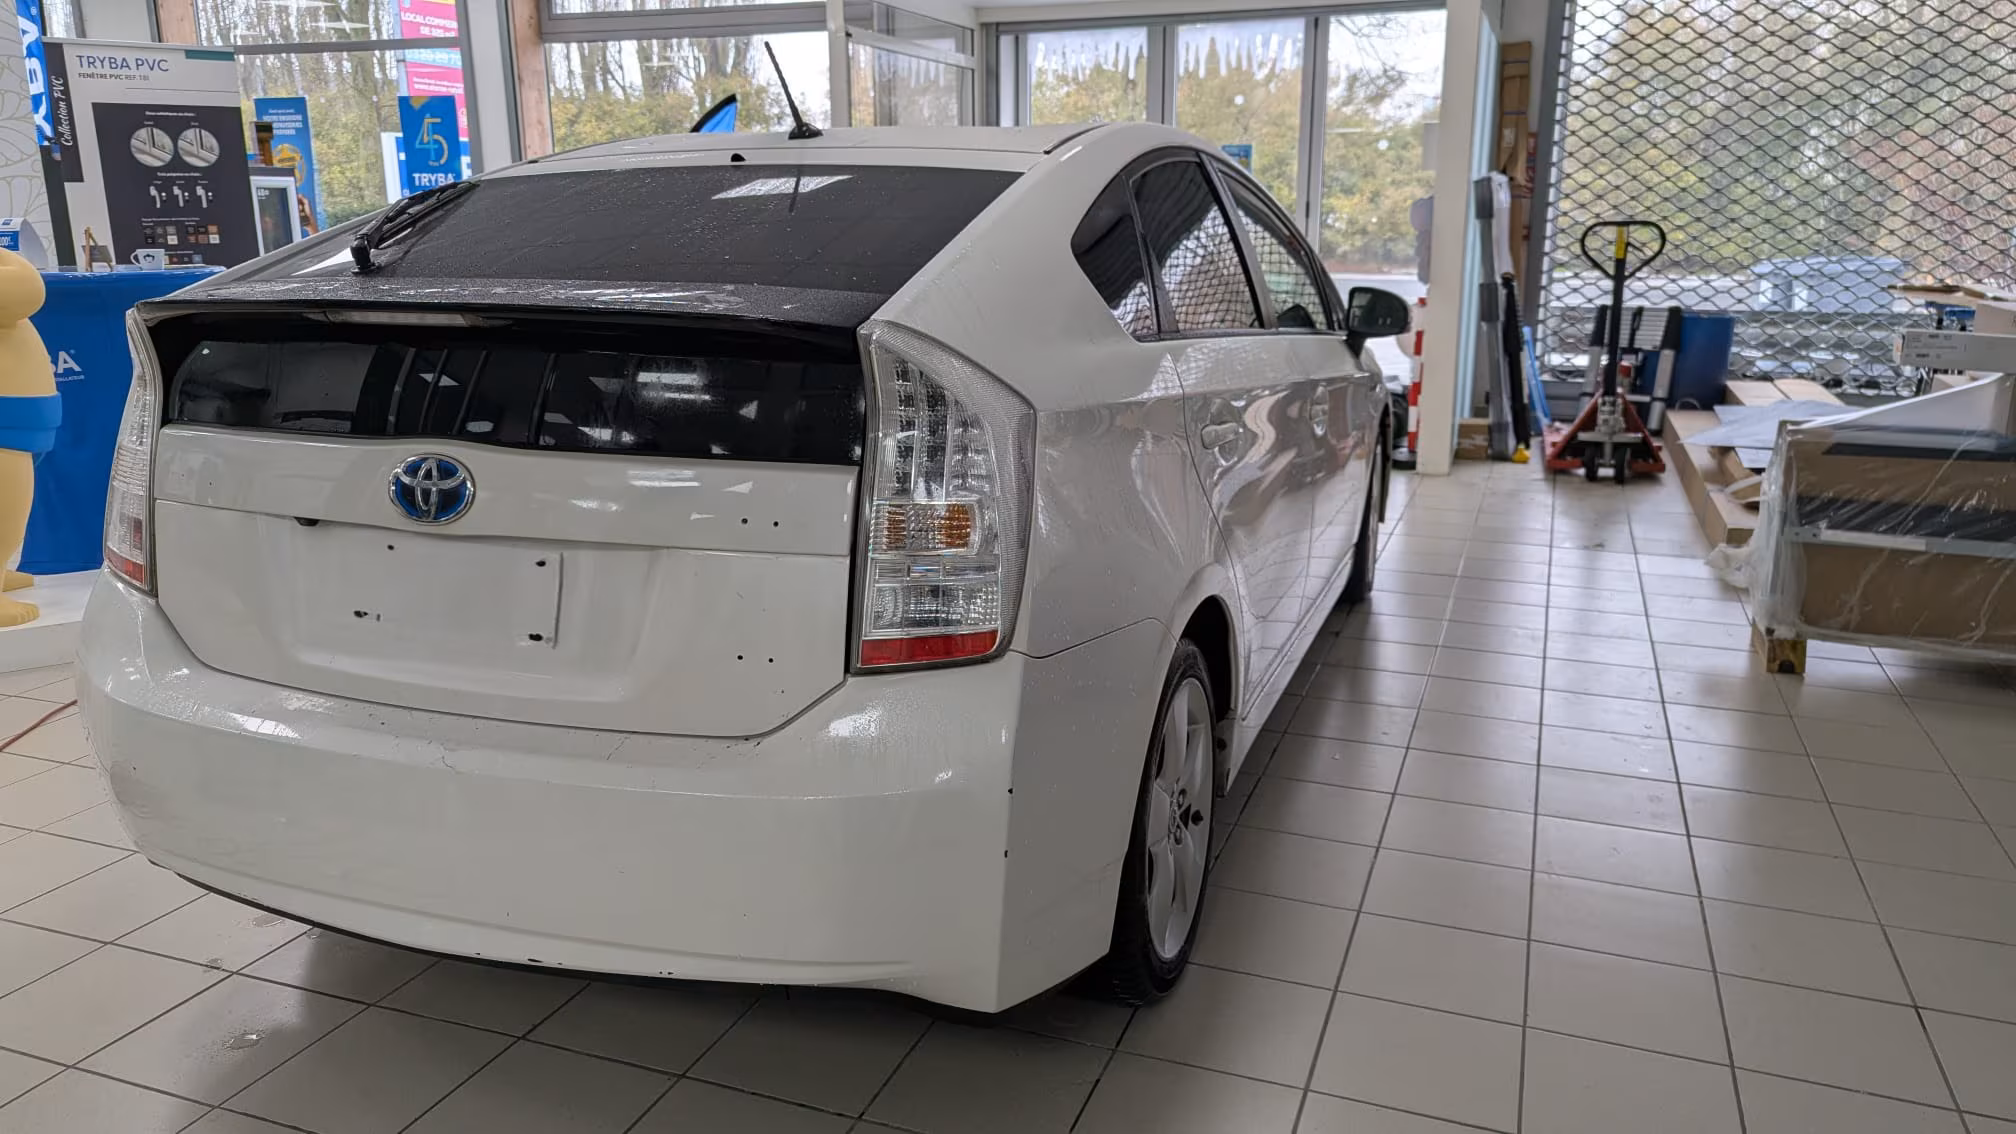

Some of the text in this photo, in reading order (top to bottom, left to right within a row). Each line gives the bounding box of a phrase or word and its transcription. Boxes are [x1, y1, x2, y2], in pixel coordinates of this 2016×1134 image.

[75, 55, 169, 72] TRYBA PVC
[78, 72, 110, 80] FENÊTRE
[50, 75, 73, 146] Collection PVC
[412, 173, 455, 187] TRYBA
